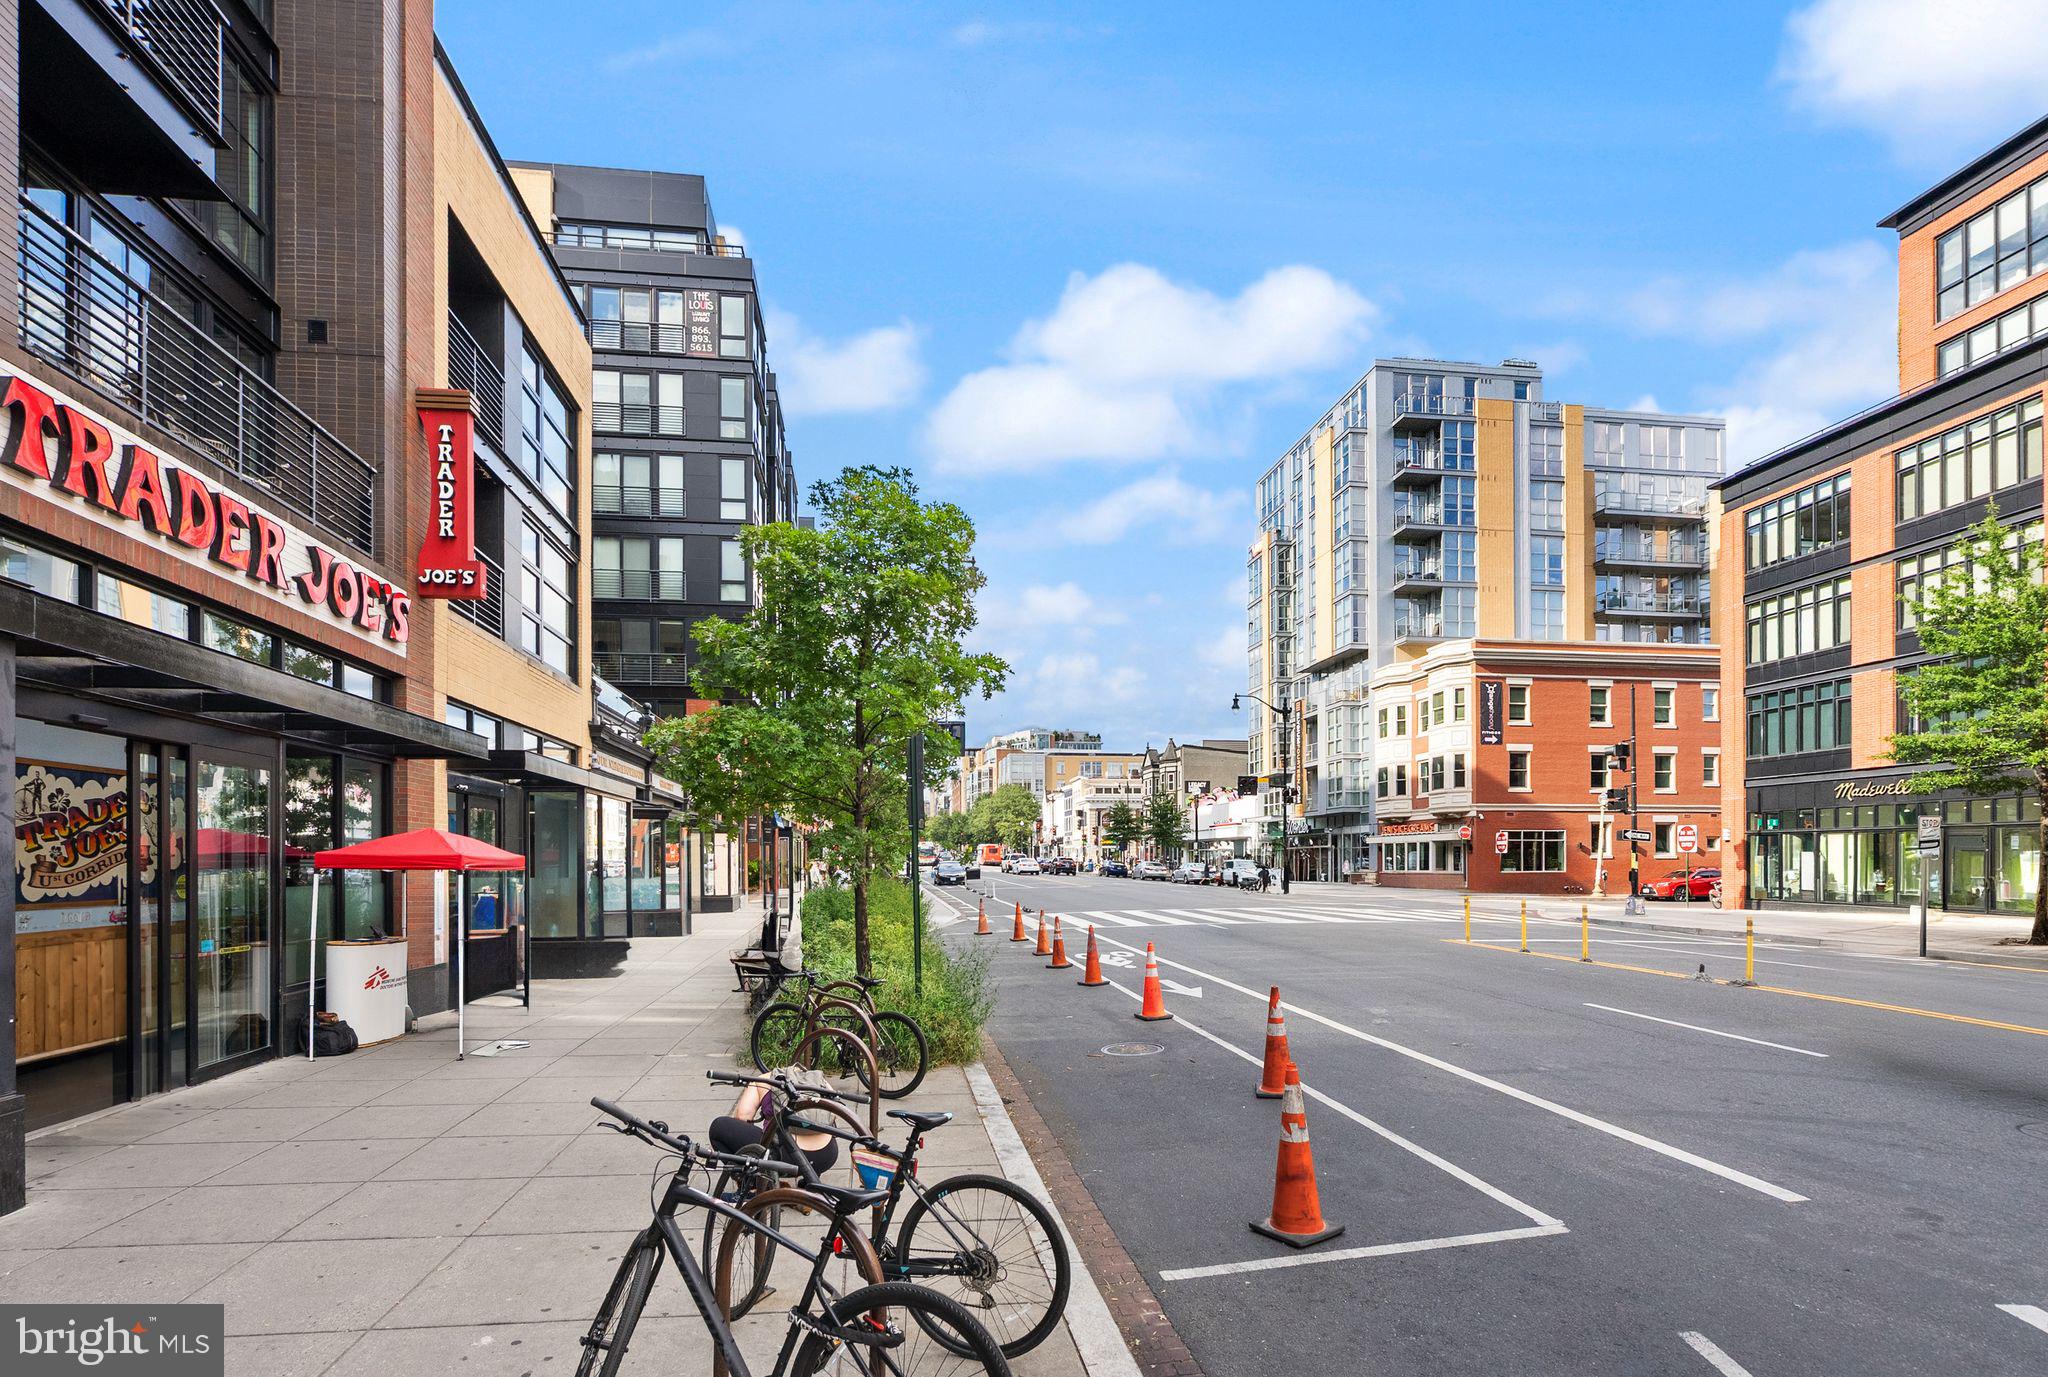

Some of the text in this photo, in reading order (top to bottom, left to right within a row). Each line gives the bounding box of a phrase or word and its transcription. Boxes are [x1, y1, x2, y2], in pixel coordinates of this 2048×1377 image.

[688, 300, 714, 310] LOUIS
[692, 291, 710, 301] THE
[437, 424, 455, 538] TRADER
[0, 376, 411, 644] TRADER JOE'S
[418, 568, 475, 586] JOE'S
[64, 851, 127, 885] CORRID
